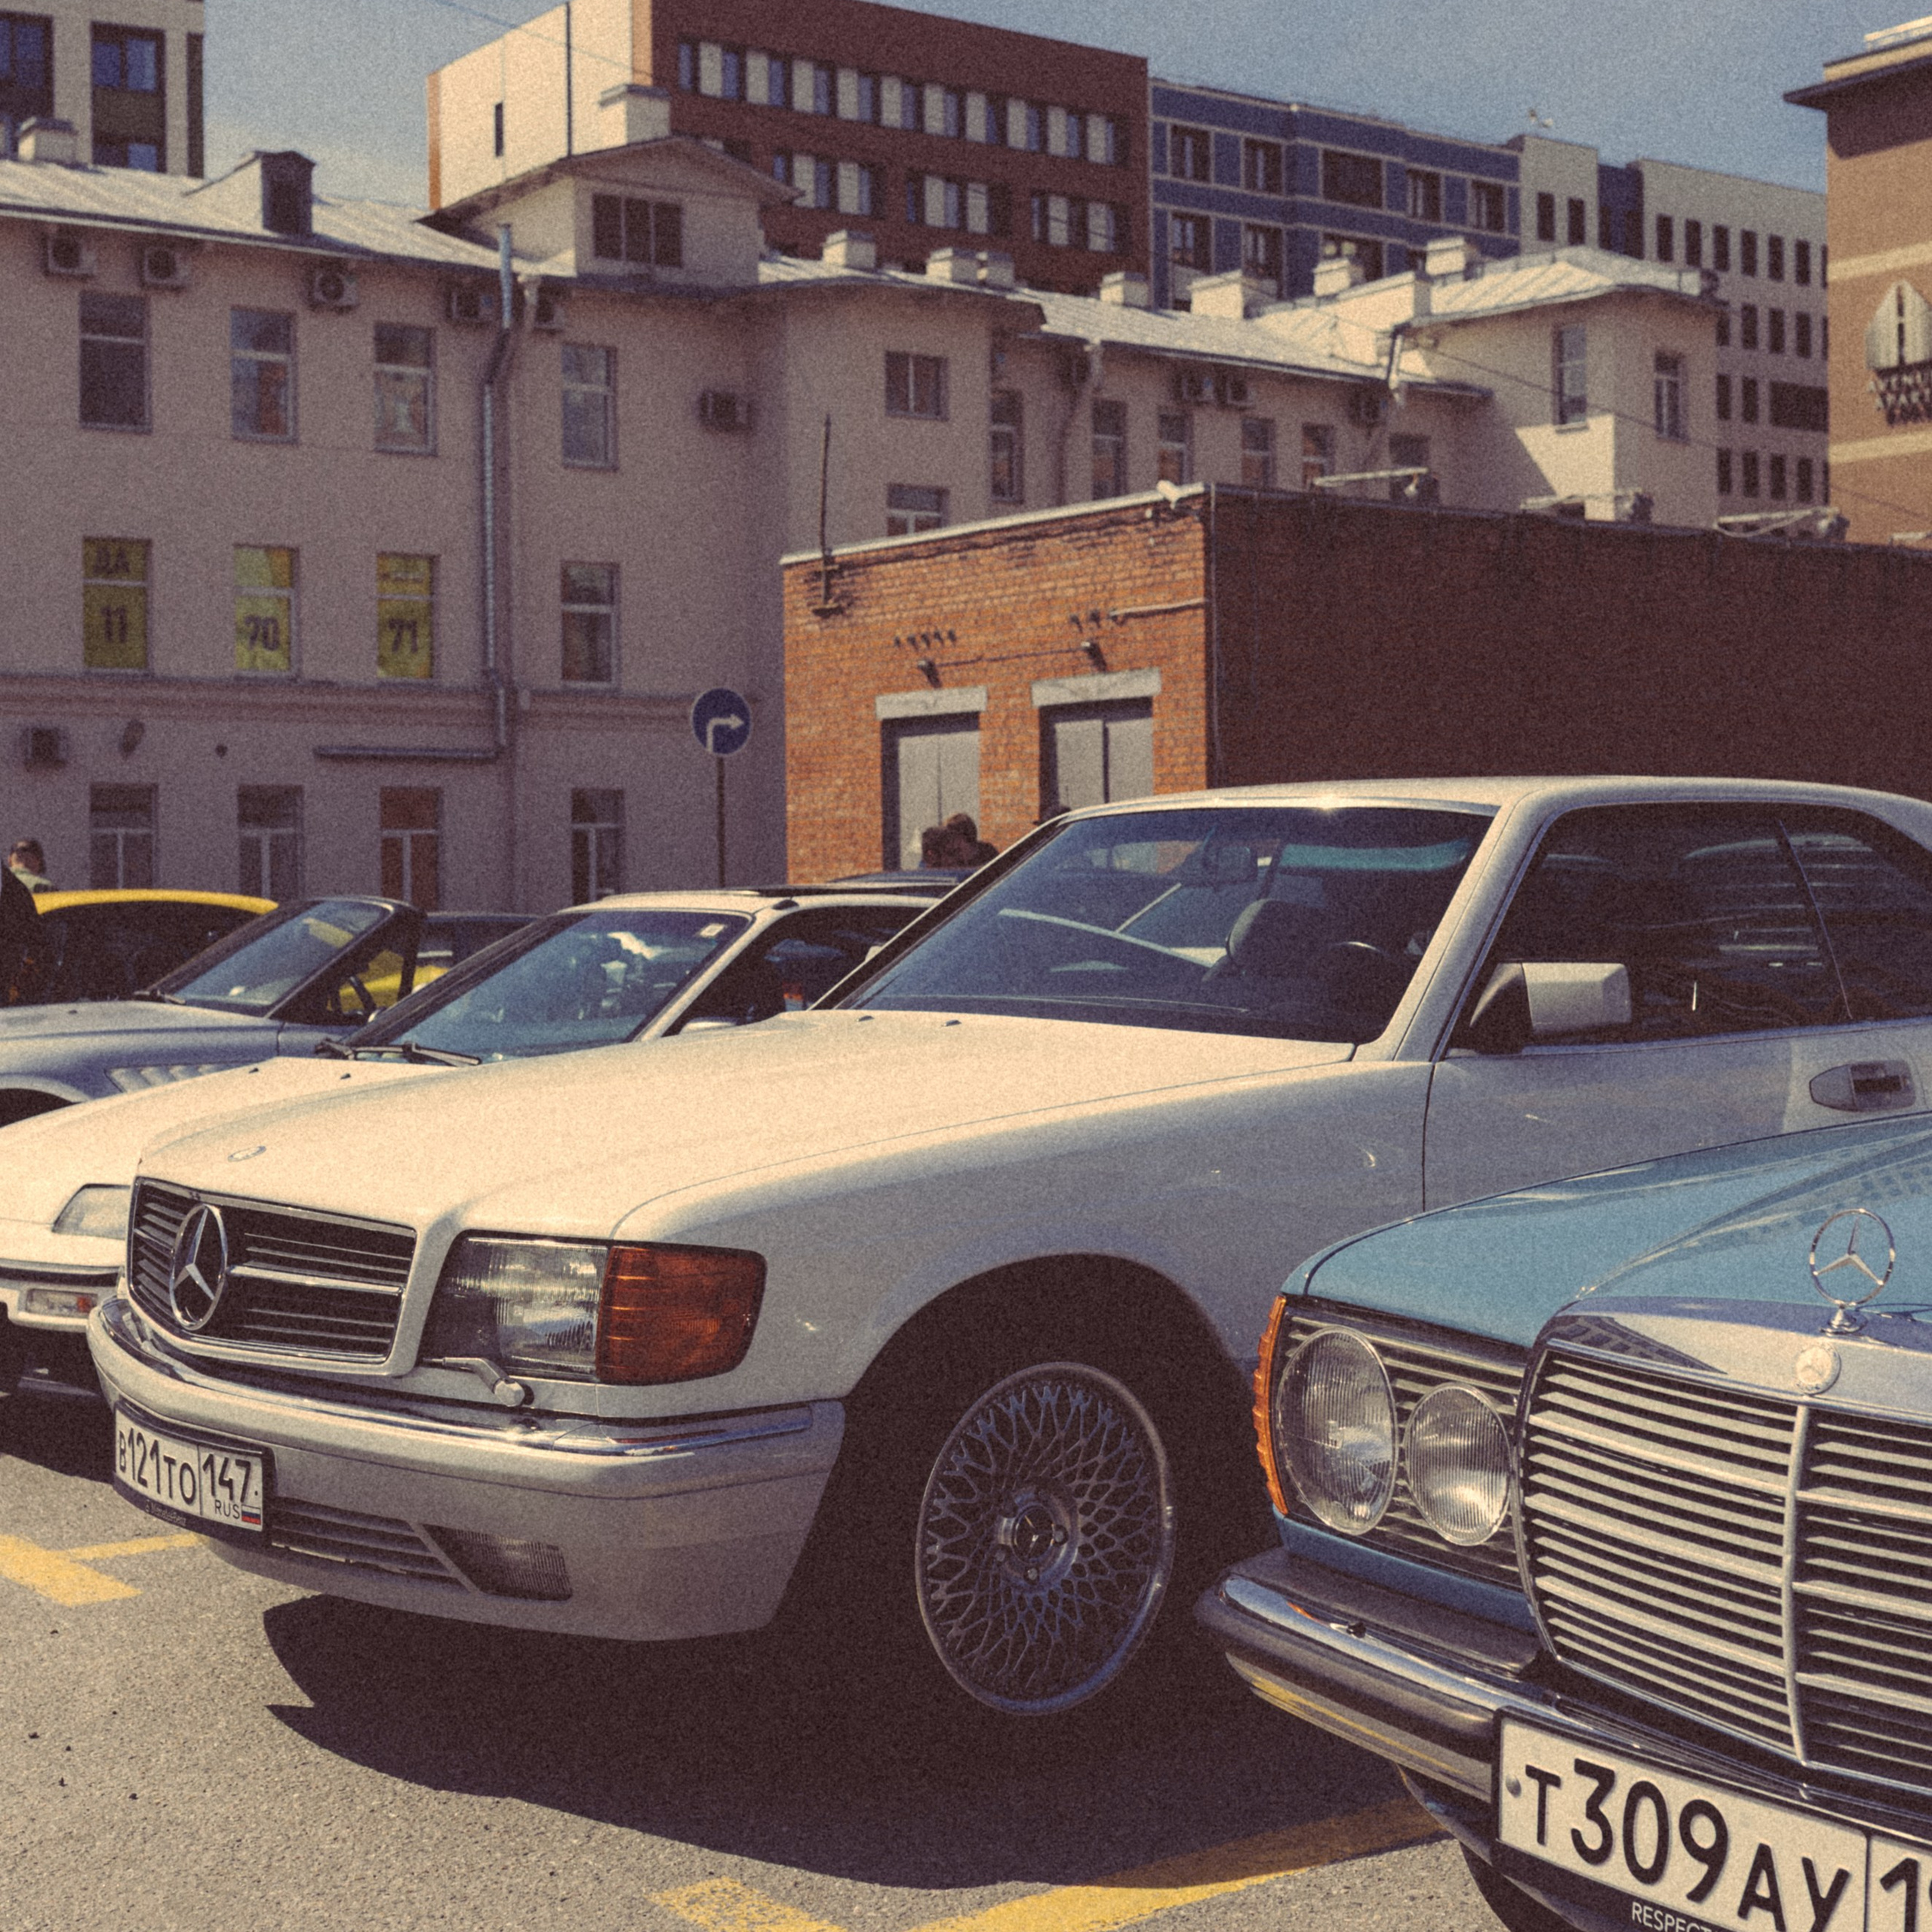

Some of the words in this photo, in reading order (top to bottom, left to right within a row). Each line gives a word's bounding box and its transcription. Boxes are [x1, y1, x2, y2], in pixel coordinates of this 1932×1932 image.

[1867, 371, 1932, 393] AVENU
[244, 615, 280, 651] 70
[388, 618, 419, 654] 71
[202, 1454, 251, 1503] 147
[214, 1500, 240, 1519] RUS
